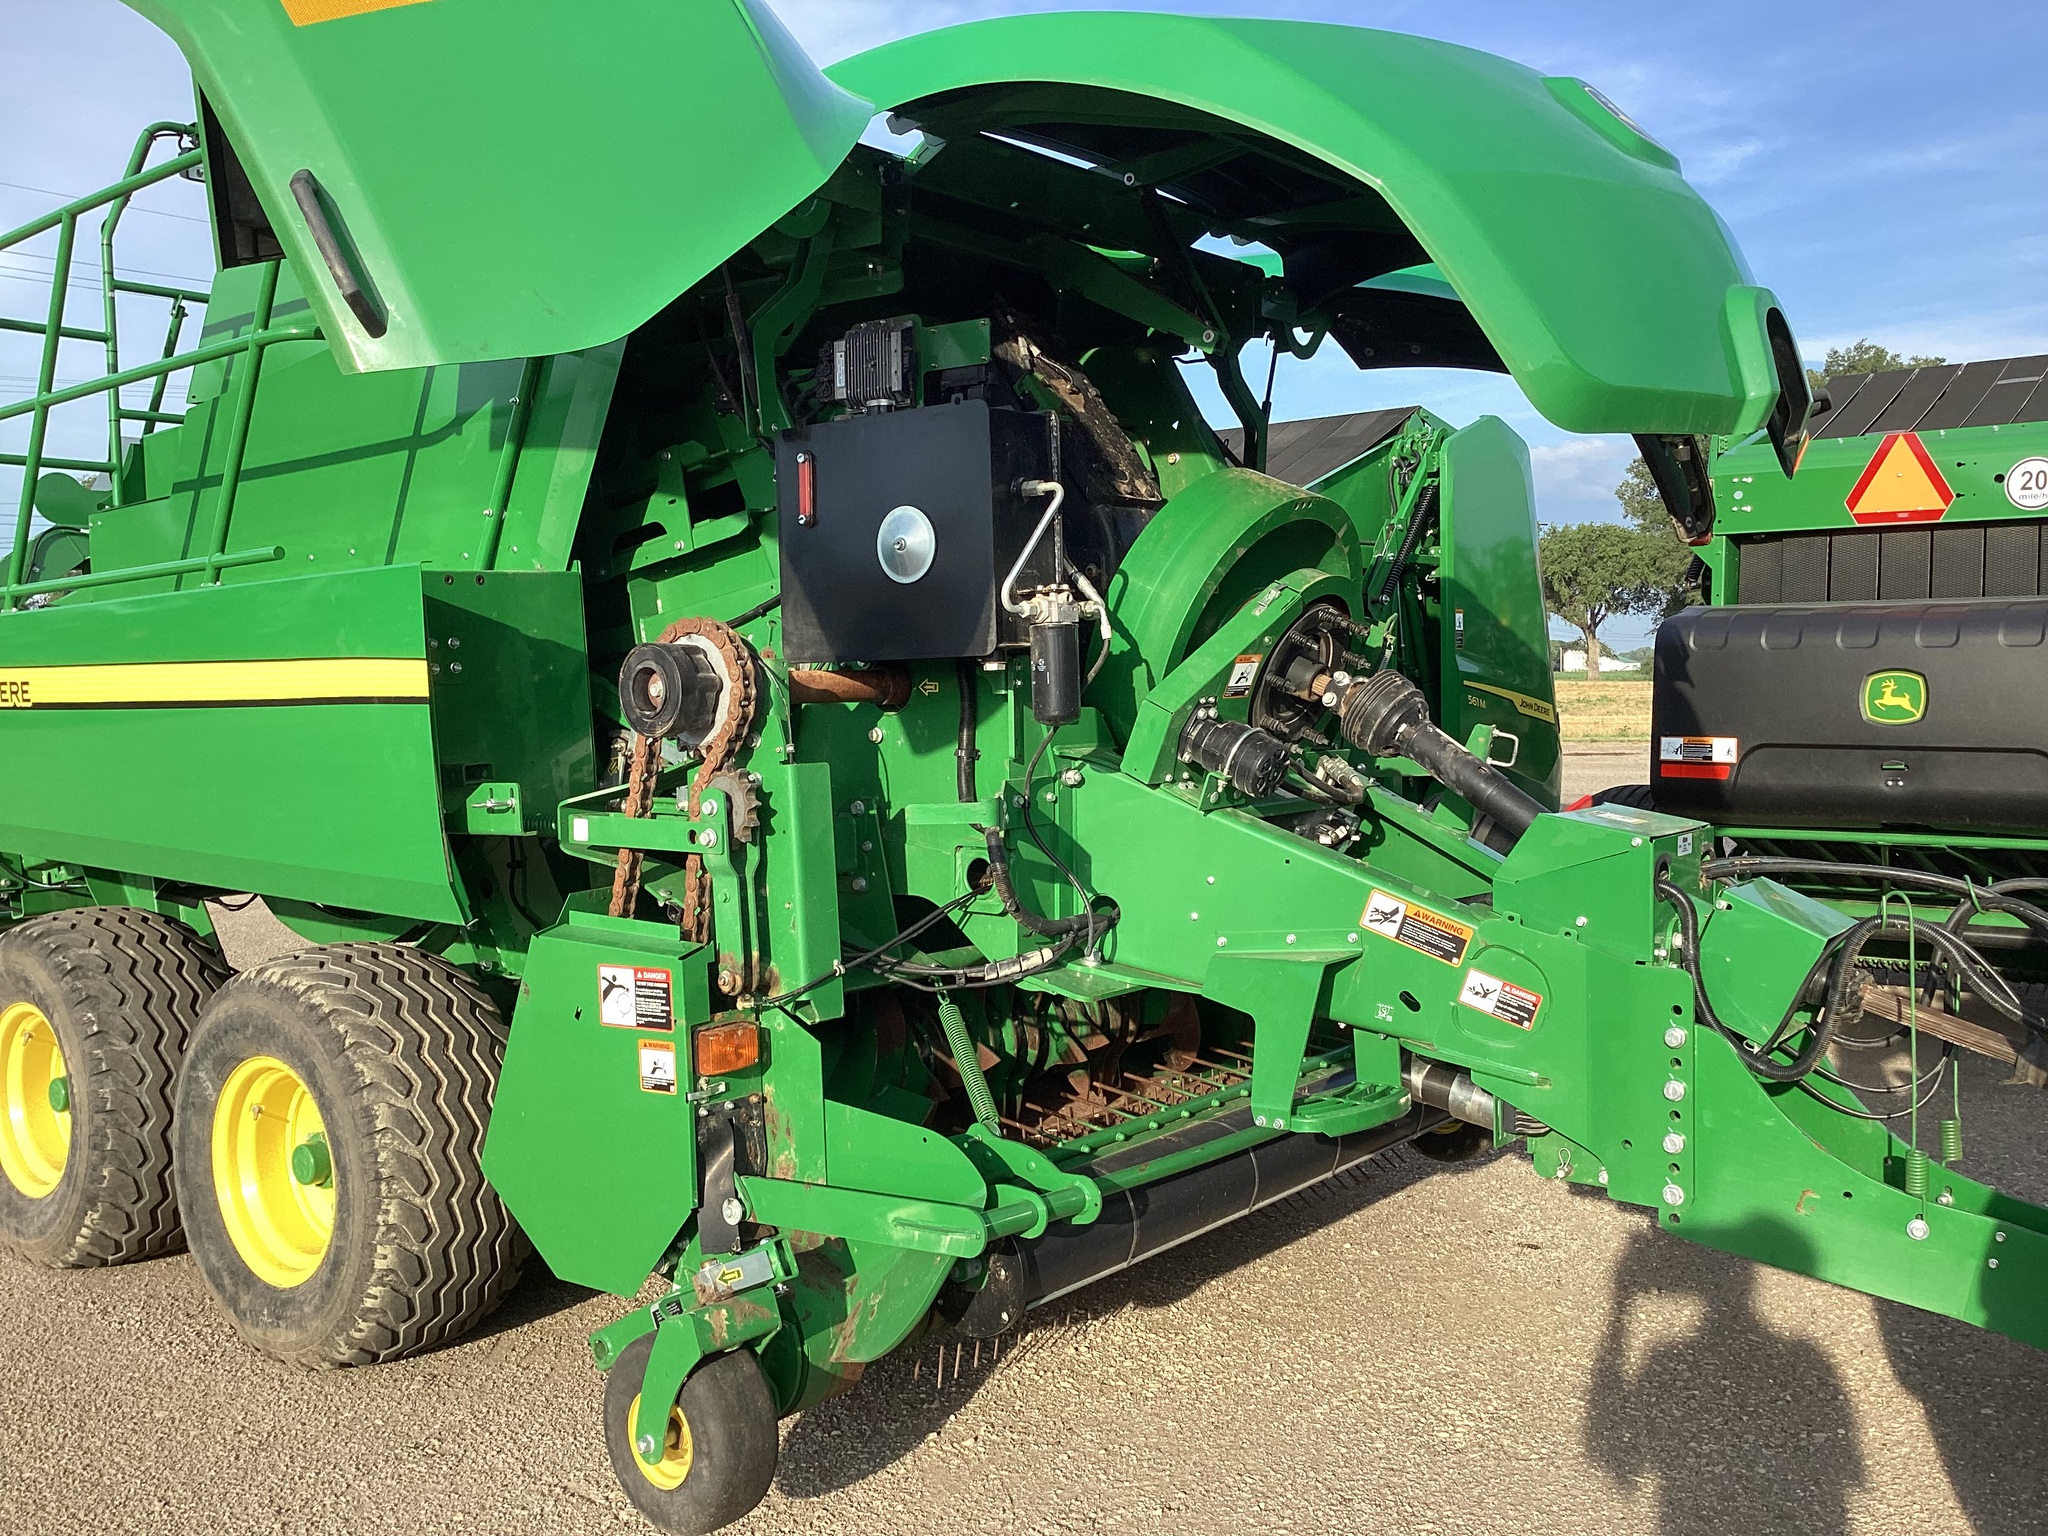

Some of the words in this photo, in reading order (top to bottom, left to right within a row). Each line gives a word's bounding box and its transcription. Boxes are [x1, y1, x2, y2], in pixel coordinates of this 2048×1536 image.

[2020, 469, 2048, 491] 20
[2018, 492, 2048, 501] mile/h
[1467, 694, 1487, 710] 561M
[1519, 698, 1534, 711] JOHN
[1533, 703, 1551, 717] DEERE
[1421, 912, 1465, 936] WARNING
[643, 971, 667, 981] DANGER
[1510, 986, 1538, 1003] DANGER
